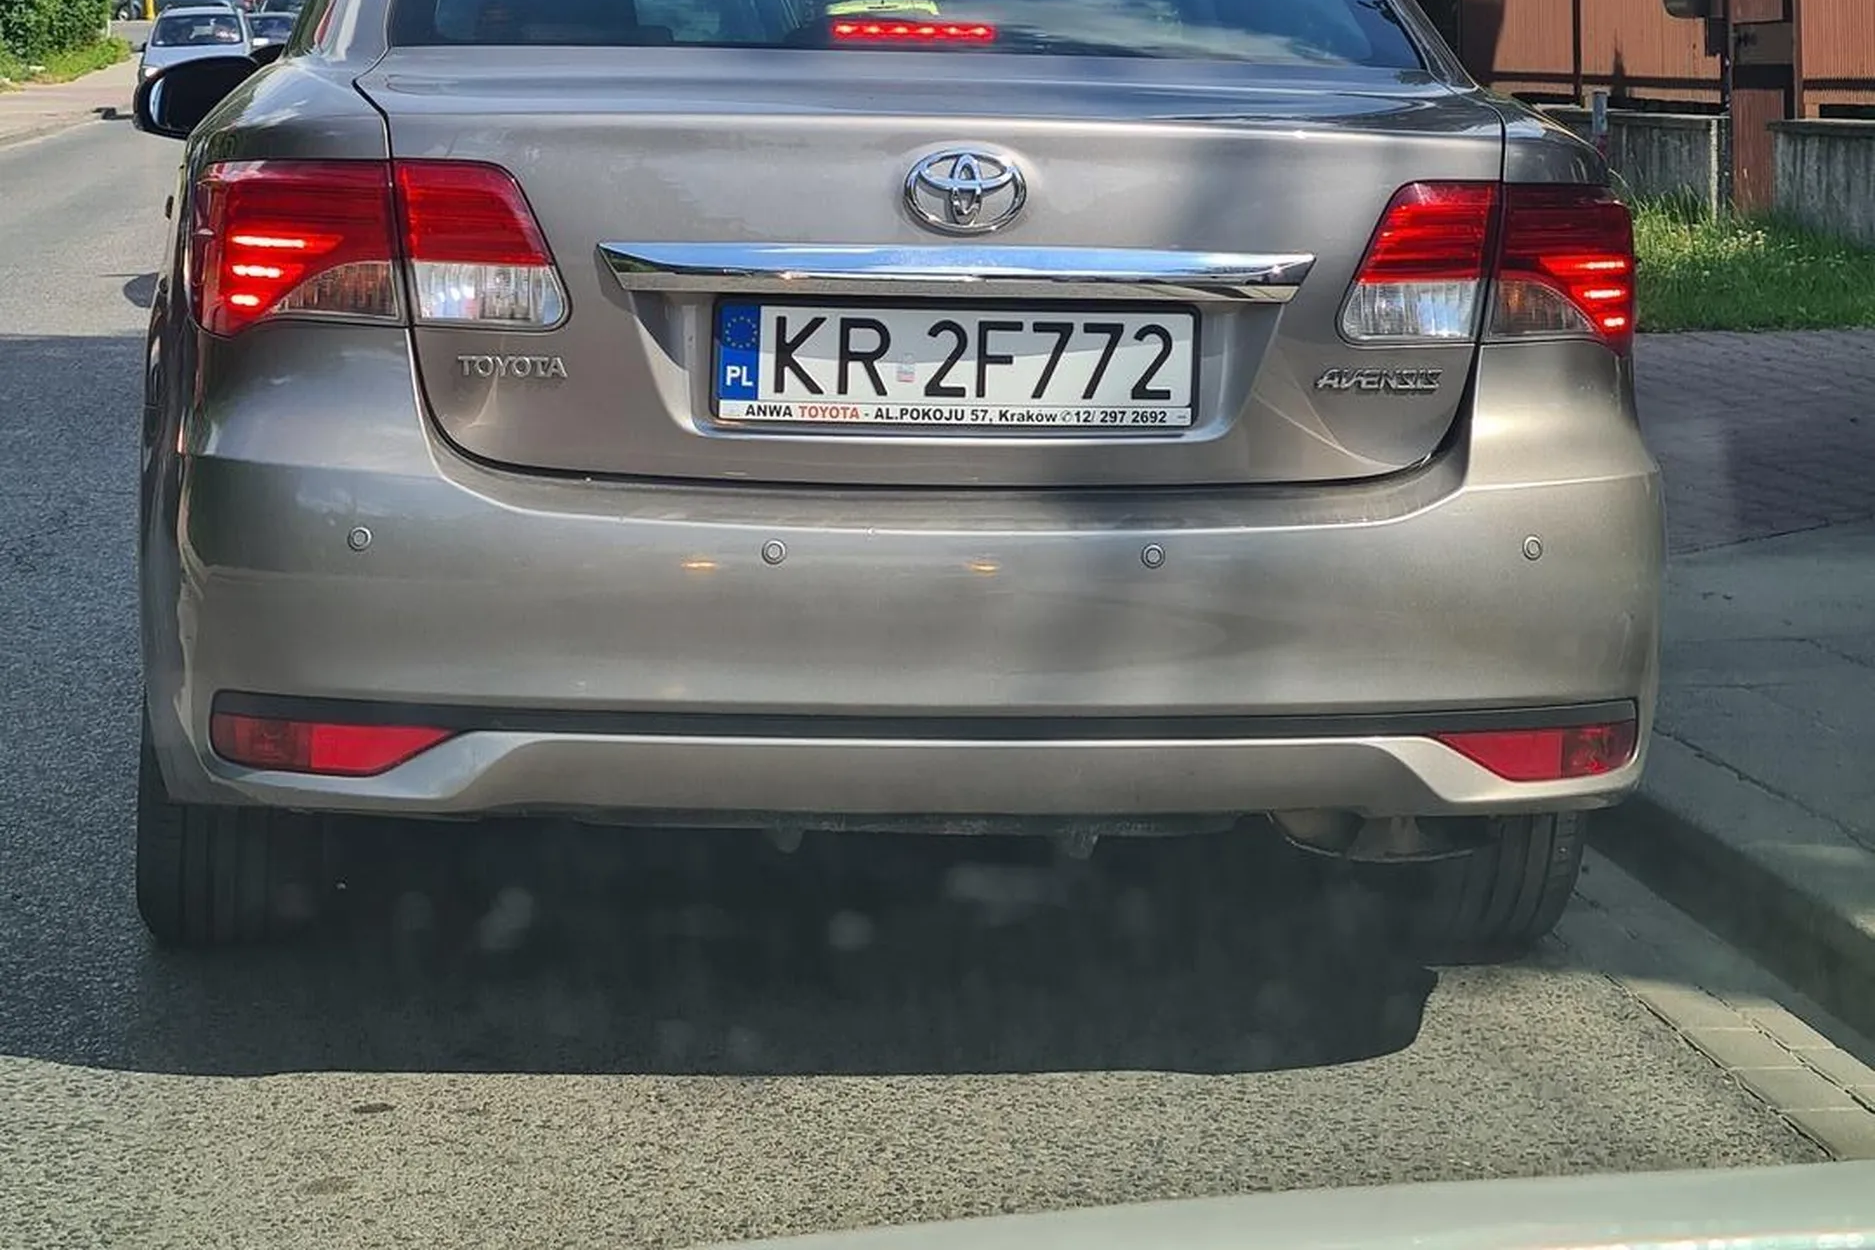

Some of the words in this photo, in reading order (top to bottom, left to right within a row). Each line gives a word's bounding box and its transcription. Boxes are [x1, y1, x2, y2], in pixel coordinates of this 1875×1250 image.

[457, 355, 569, 378] TOYOTA
[773, 314, 892, 397] KR
[923, 318, 1173, 401] 2F772
[725, 365, 754, 388] PL
[1316, 367, 1444, 390] AVENSIS
[745, 404, 793, 418] ANWA
[798, 405, 860, 420] TOYOTA
[874, 407, 965, 422] AL.POKOJU
[970, 409, 993, 423] 57,
[998, 409, 1057, 423] Kraków
[1099, 410, 1126, 424] 297
[1131, 410, 1168, 424] 2692
